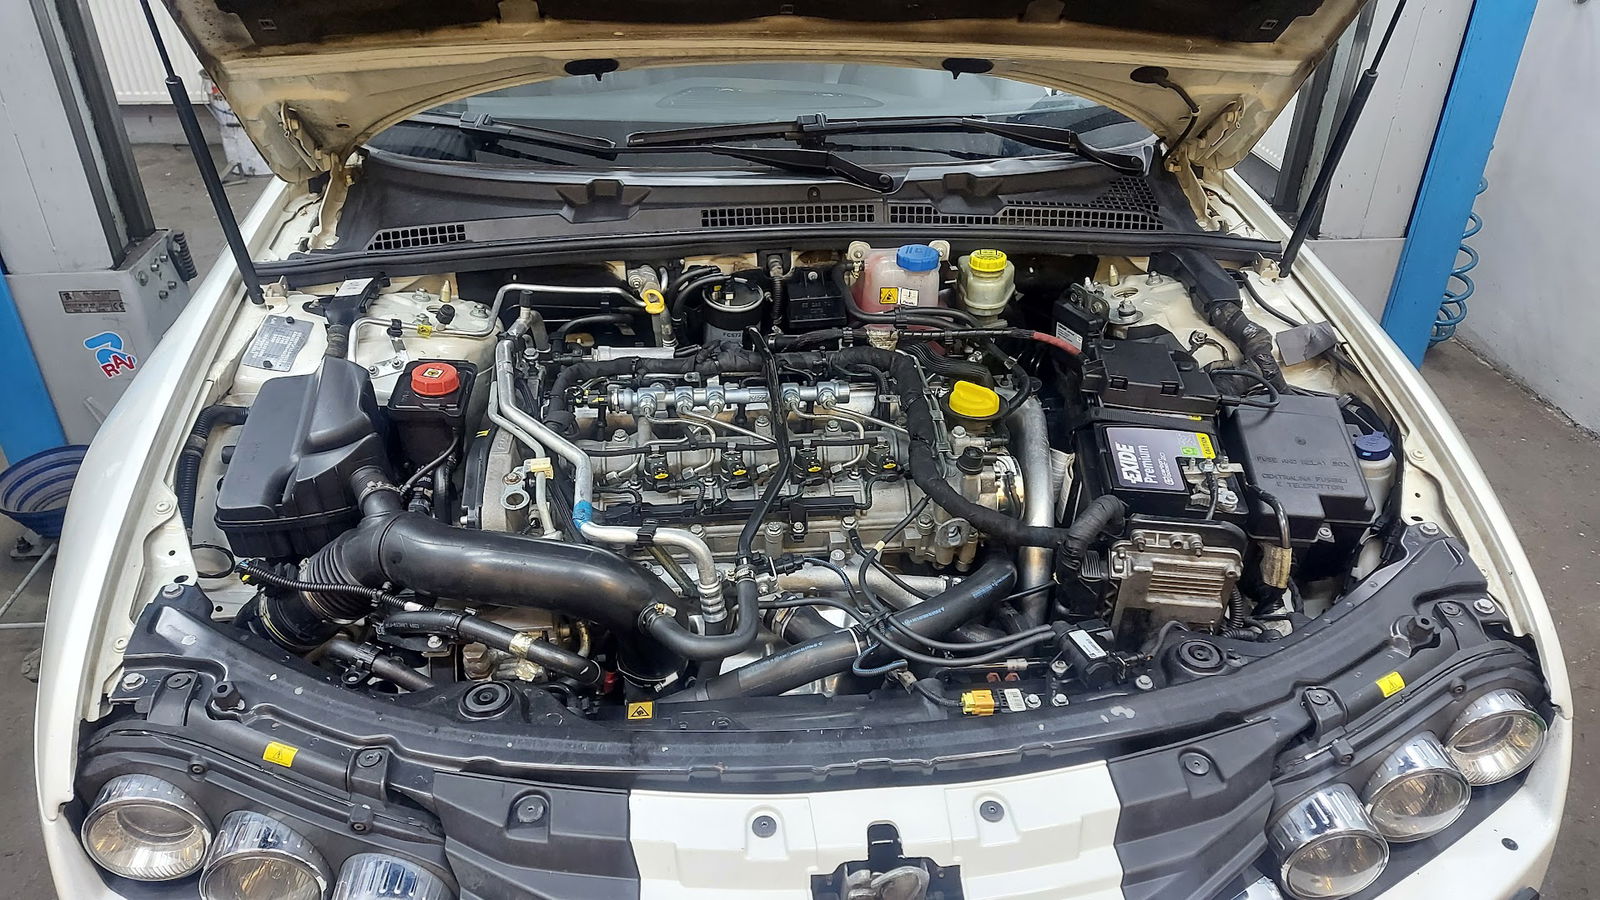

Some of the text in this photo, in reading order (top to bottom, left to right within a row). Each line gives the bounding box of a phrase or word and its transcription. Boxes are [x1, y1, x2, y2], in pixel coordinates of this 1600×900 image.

[100, 353, 136, 378] RAV
[1114, 441, 1143, 484] EXIDE
[1138, 445, 1158, 483] Premium
